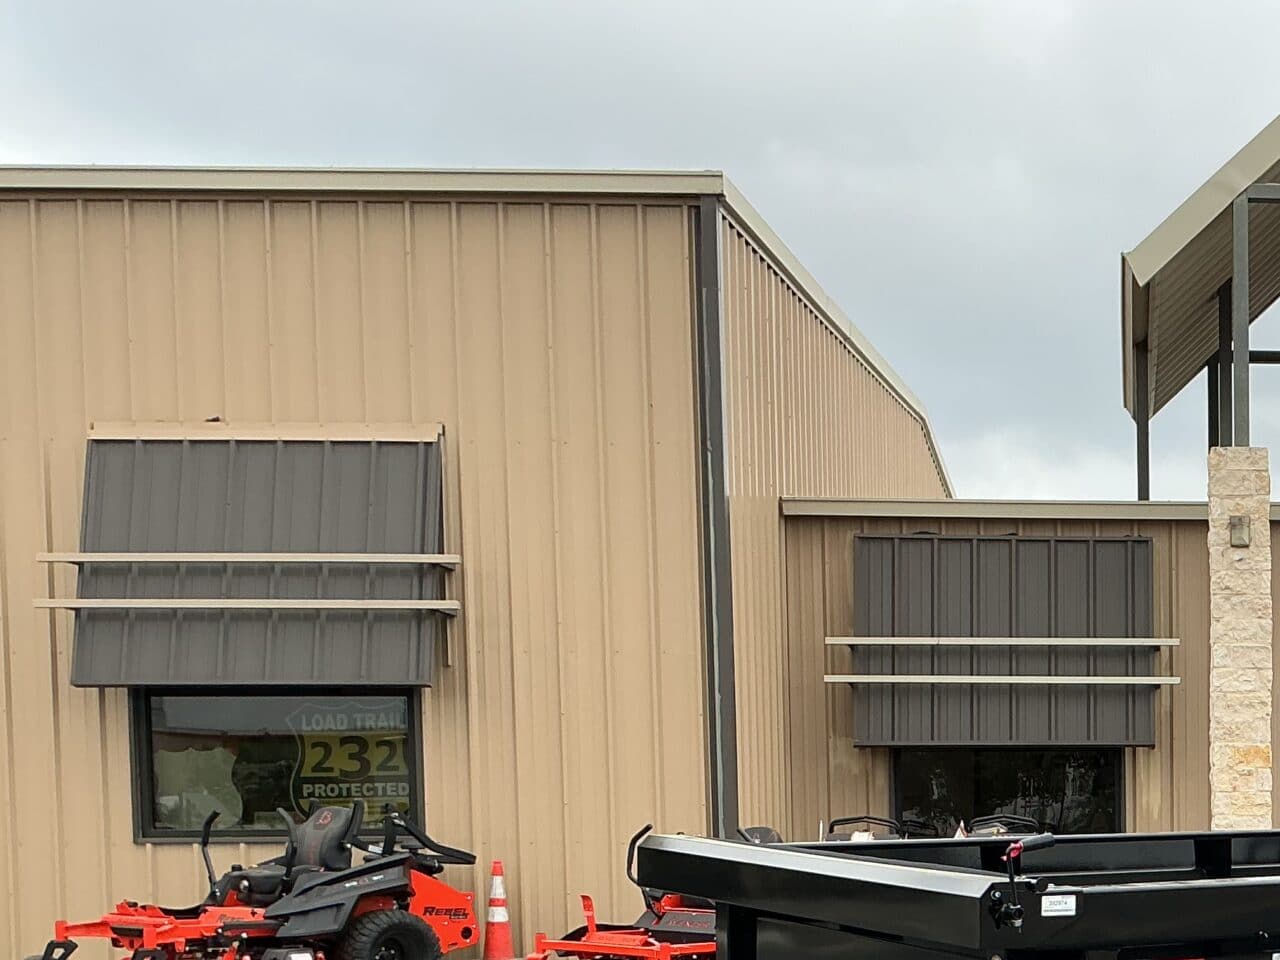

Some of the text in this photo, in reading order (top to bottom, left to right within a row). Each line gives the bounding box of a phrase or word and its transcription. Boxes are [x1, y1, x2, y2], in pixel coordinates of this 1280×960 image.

[303, 712, 407, 730] LOAD TRAIL
[311, 735, 400, 780] 232
[303, 782, 410, 798] PROTECTED
